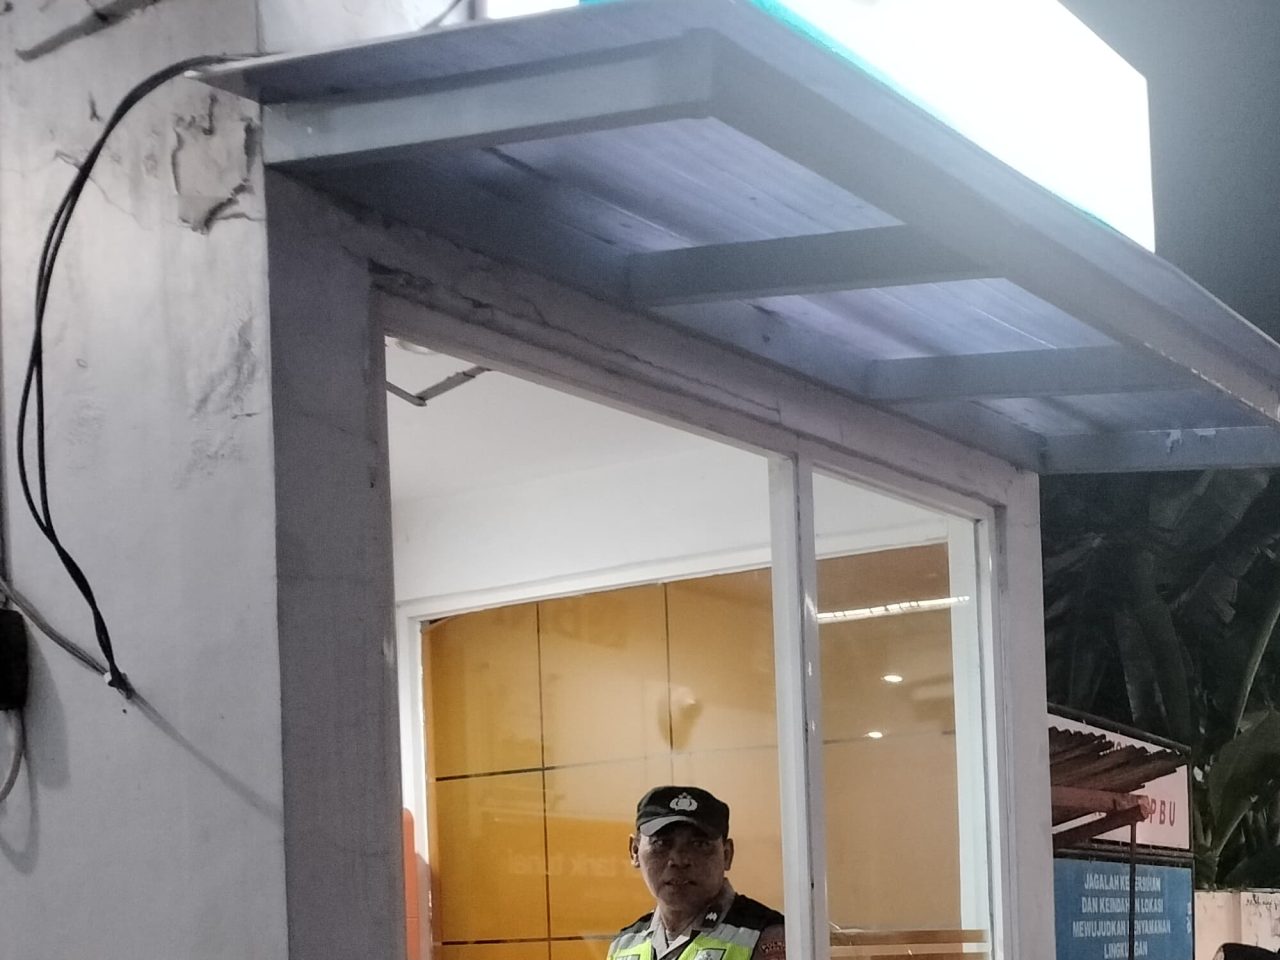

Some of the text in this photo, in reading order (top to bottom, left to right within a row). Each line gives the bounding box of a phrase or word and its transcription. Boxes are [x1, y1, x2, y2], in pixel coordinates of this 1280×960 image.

[1084, 873, 1161, 892] JAGALAH KEERSIHAN
[1082, 897, 1164, 914] DAN KEINDAHN LOKASI
[1072, 920, 1126, 938] MEWUJUDKAN
[1104, 940, 1148, 959] LINGKUGAN
